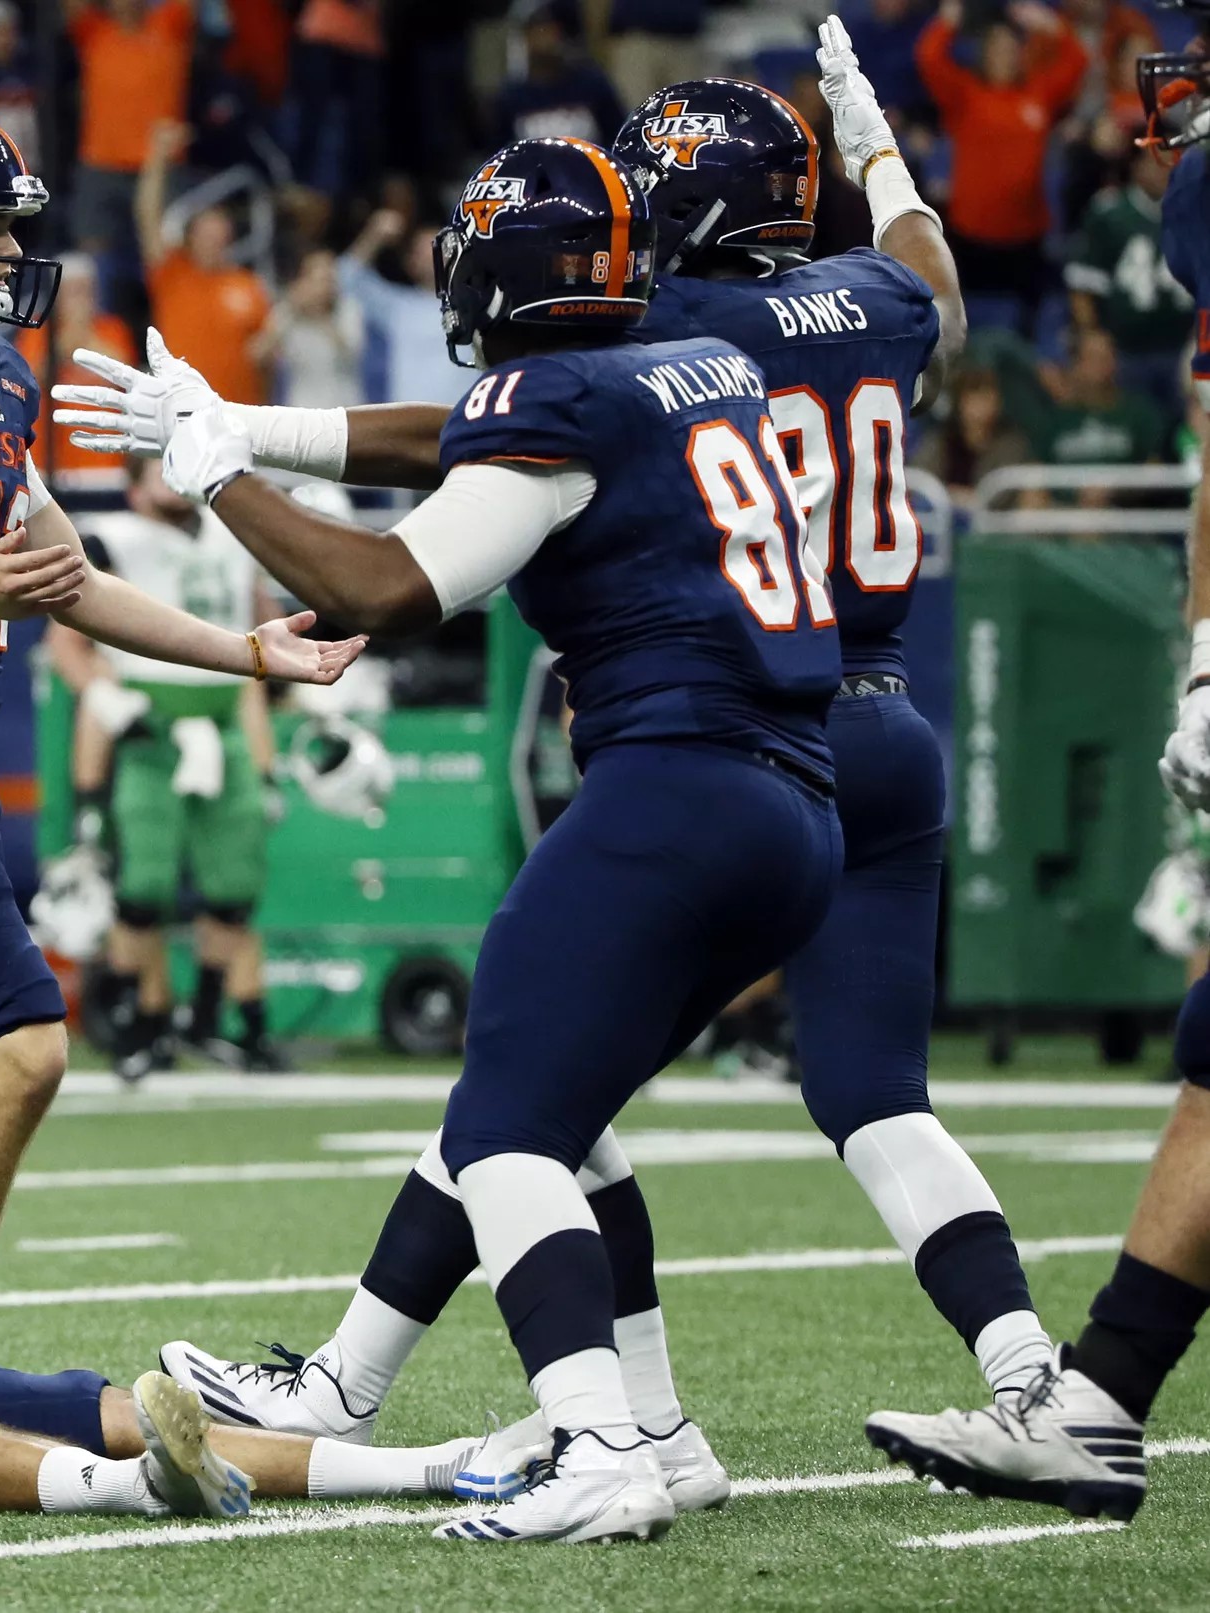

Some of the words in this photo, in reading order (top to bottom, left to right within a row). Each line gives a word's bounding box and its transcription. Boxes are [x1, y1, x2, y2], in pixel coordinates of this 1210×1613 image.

[651, 115, 723, 137] UTSA
[464, 180, 522, 203] UTSA
[766, 288, 868, 338] BANKS
[463, 369, 525, 421] 81
[635, 355, 766, 414] WILLIAMS
